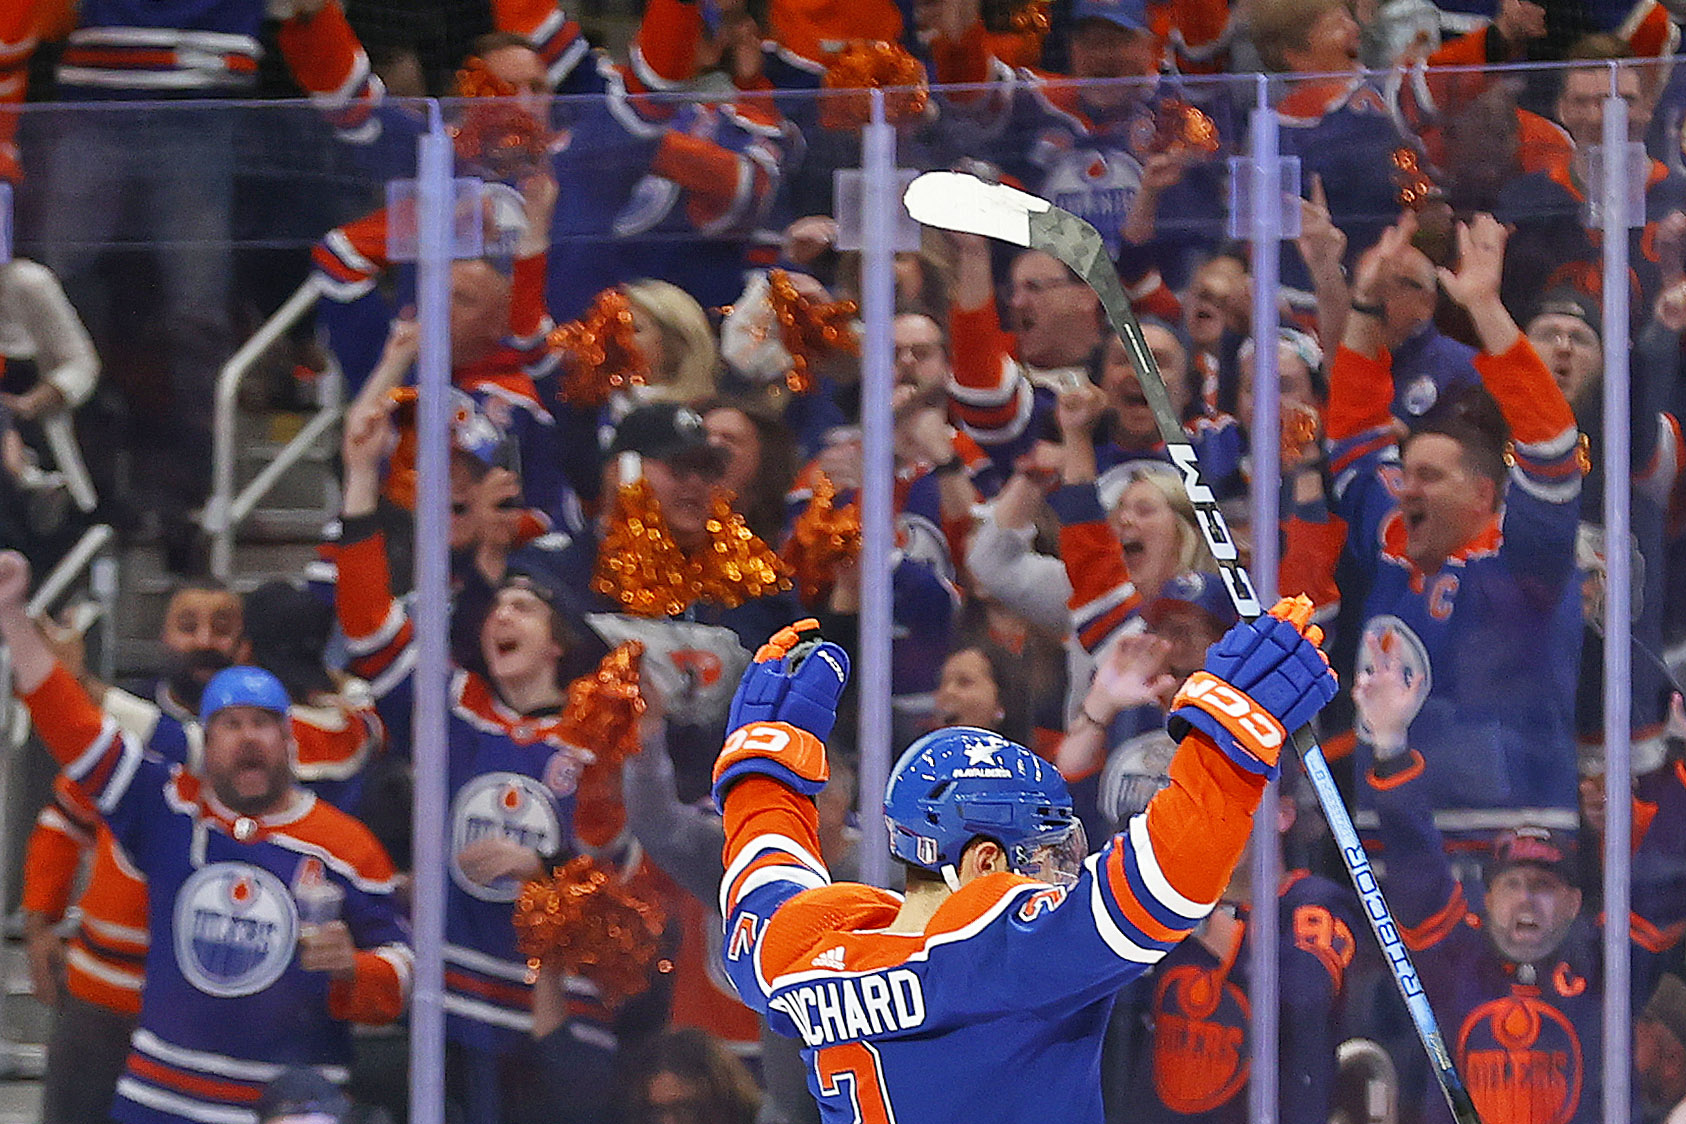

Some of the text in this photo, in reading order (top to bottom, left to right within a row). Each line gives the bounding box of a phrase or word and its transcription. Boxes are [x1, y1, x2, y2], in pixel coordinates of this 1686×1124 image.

[1167, 443, 1263, 618] CCM
[1429, 574, 1460, 621] C
[1343, 844, 1425, 997] RIBCOR
[1554, 961, 1588, 998] C
